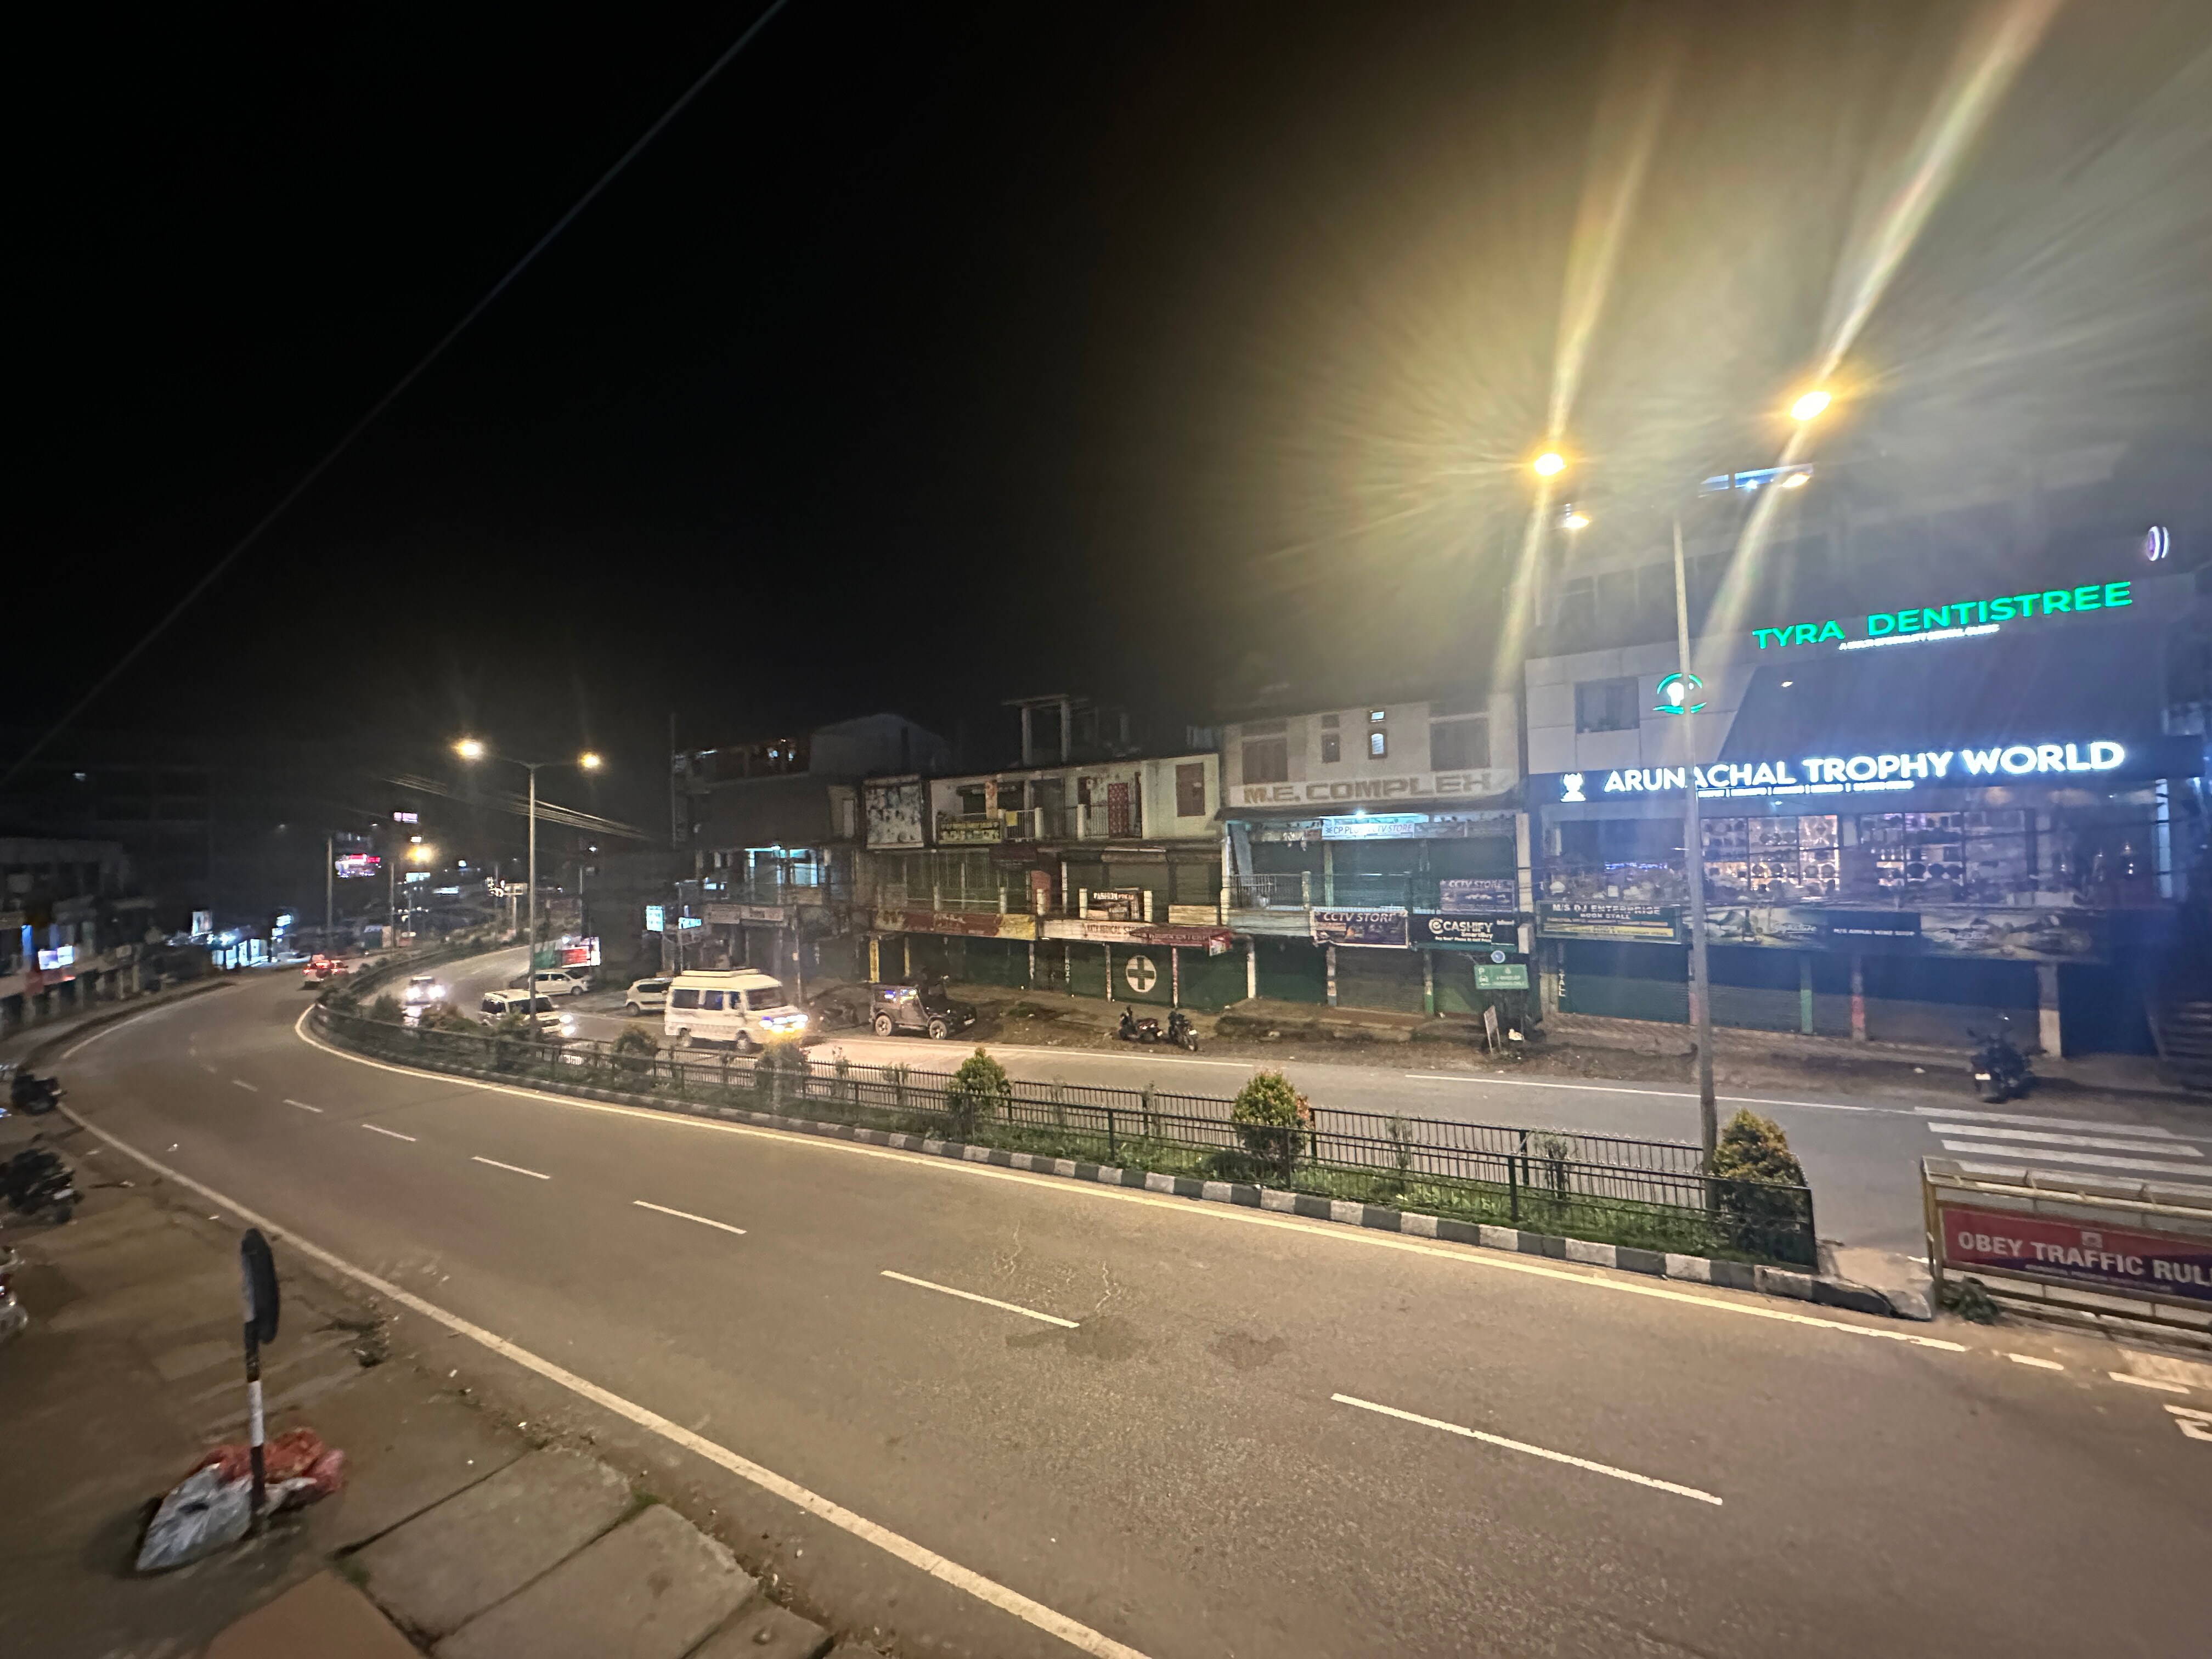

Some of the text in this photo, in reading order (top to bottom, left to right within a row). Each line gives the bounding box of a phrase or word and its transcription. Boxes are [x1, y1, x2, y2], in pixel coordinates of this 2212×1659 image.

[1752, 620, 1844, 649] TYRA
[1867, 581, 2133, 636] DENTISTREE
[1803, 751, 1953, 783] TROPHY
[1960, 741, 2125, 775] WORLD
[1244, 785, 1300, 804] M.E.
[1334, 826, 1344, 834] CP
[1345, 825, 1362, 834] PLU
[1388, 824, 1412, 832] STORE
[1323, 912, 1353, 922] CCTV
[1443, 921, 1493, 933] CASHIFY
[1957, 1231, 2023, 1257] OBEY
[2030, 1241, 2144, 1276] TRAFFIC
[2153, 1259, 2212, 1287] RUL
